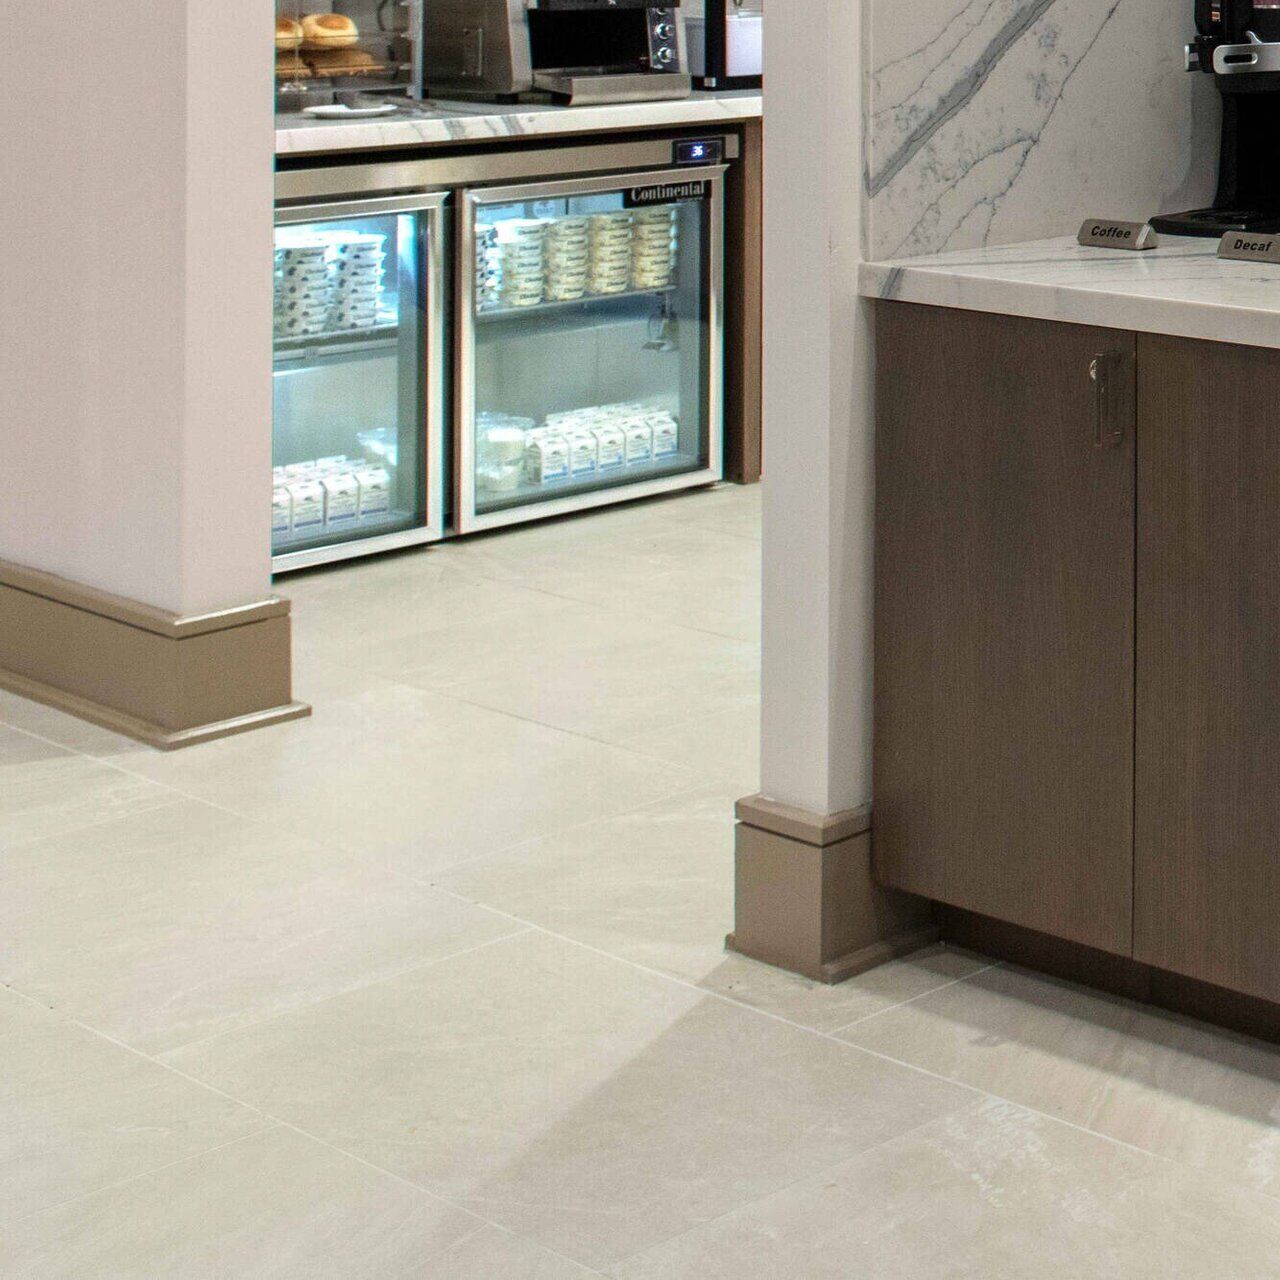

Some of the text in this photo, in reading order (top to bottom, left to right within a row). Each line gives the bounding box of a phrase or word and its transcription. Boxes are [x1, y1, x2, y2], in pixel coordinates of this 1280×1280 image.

[631, 181, 705, 201] Continental
[1091, 225, 1132, 240] Coffee
[1233, 239, 1274, 253] Decaf
